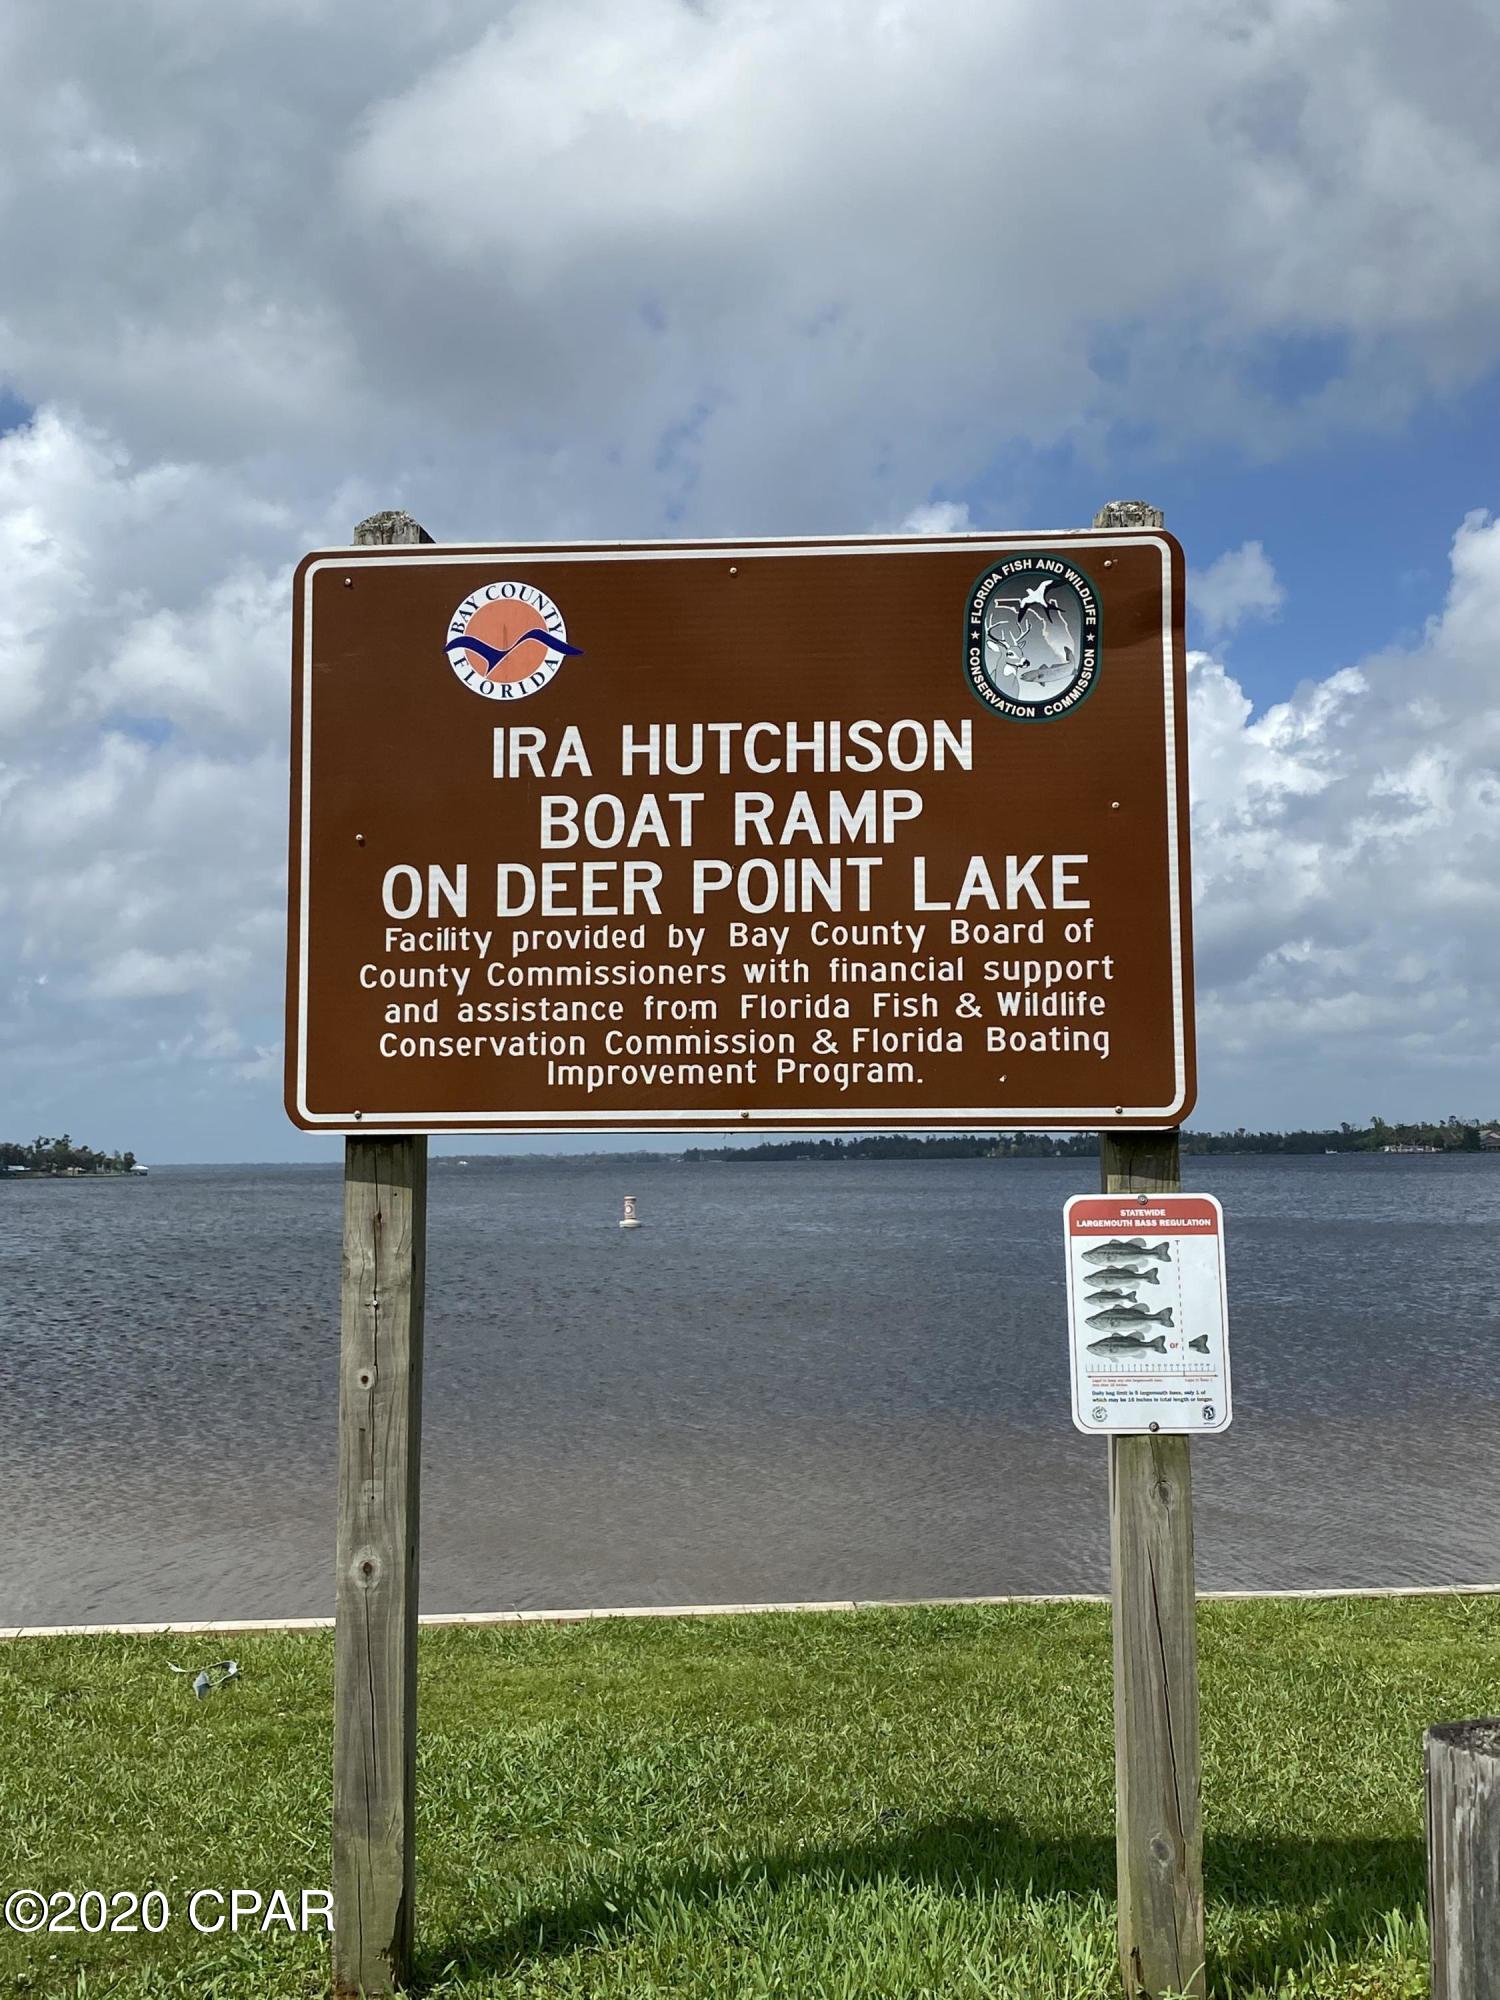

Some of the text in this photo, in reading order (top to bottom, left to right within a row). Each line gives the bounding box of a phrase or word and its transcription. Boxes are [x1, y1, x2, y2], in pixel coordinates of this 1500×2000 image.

[451, 583, 563, 634] BAY COUNTY
[971, 559, 1097, 625] FLORIDA FISH AND WILDLIFE
[454, 657, 559, 698] FLORIDA
[969, 648, 1095, 717] CONSERVATION COMMISSION
[493, 719, 973, 779] IRA HUTCHISON
[540, 789, 923, 850] BOAT RAMP
[382, 854, 1091, 920] ON DEER POINT LAKE
[385, 917, 1094, 959] Facility provided by Bay County Board of
[359, 955, 1114, 996] County Commissioners with financial support
[384, 990, 1106, 1024] and assistance from Florida Fish & Wildlife
[379, 1026, 1110, 1060] Conservation Commission & Florida Boating
[547, 1058, 923, 1094] Improvement Program.
[1076, 1218, 1211, 1228] LARGEMOUTH BASS REGULATION
[1120, 1209, 1167, 1217] STATEWIDE
